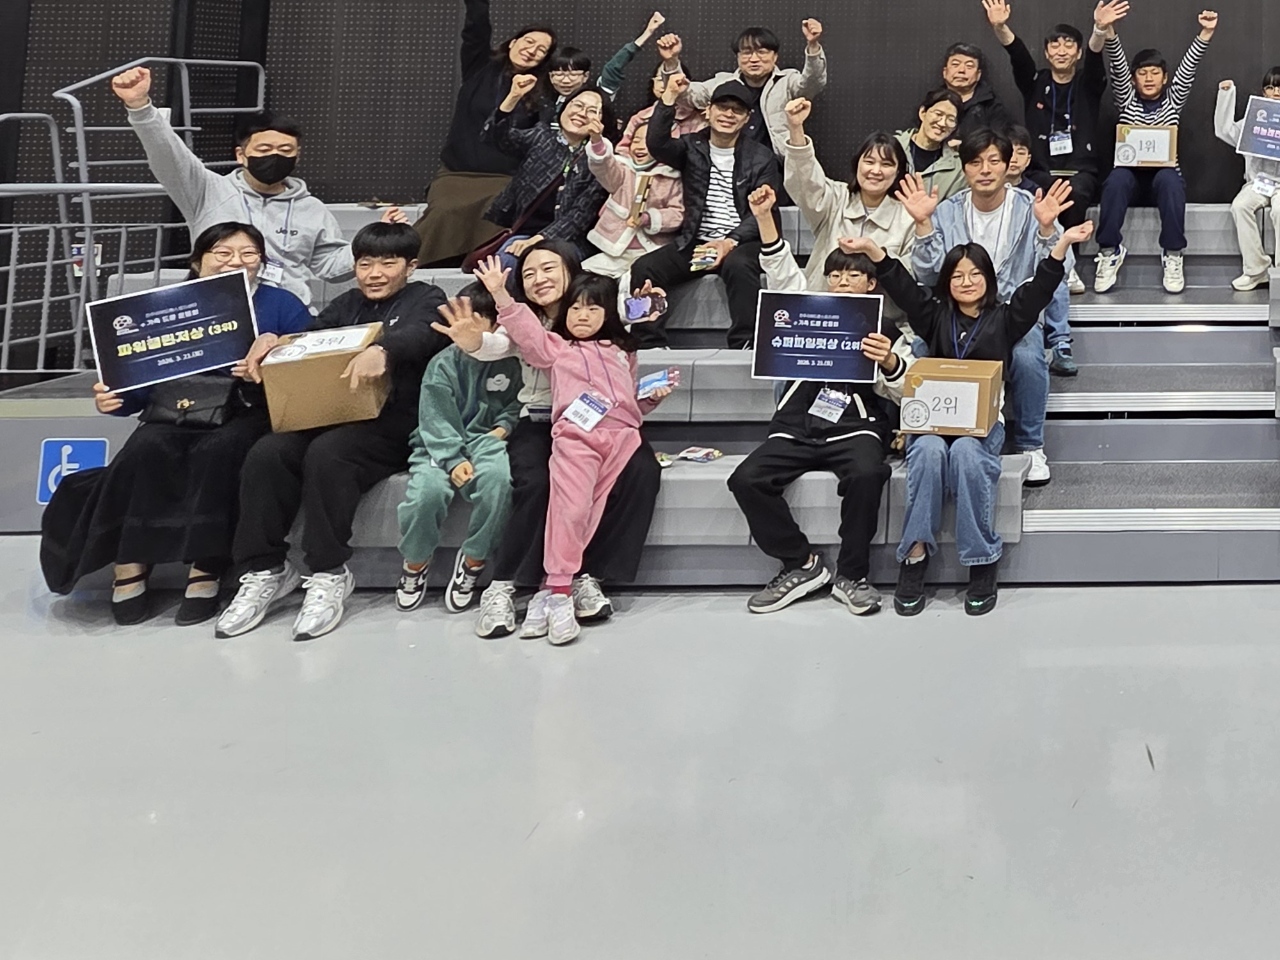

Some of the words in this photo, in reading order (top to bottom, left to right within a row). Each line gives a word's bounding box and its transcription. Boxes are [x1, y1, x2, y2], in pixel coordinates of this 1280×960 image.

[1139, 139, 1156, 153] 1위
[311, 335, 346, 347] 3위
[931, 396, 958, 415] 2위
